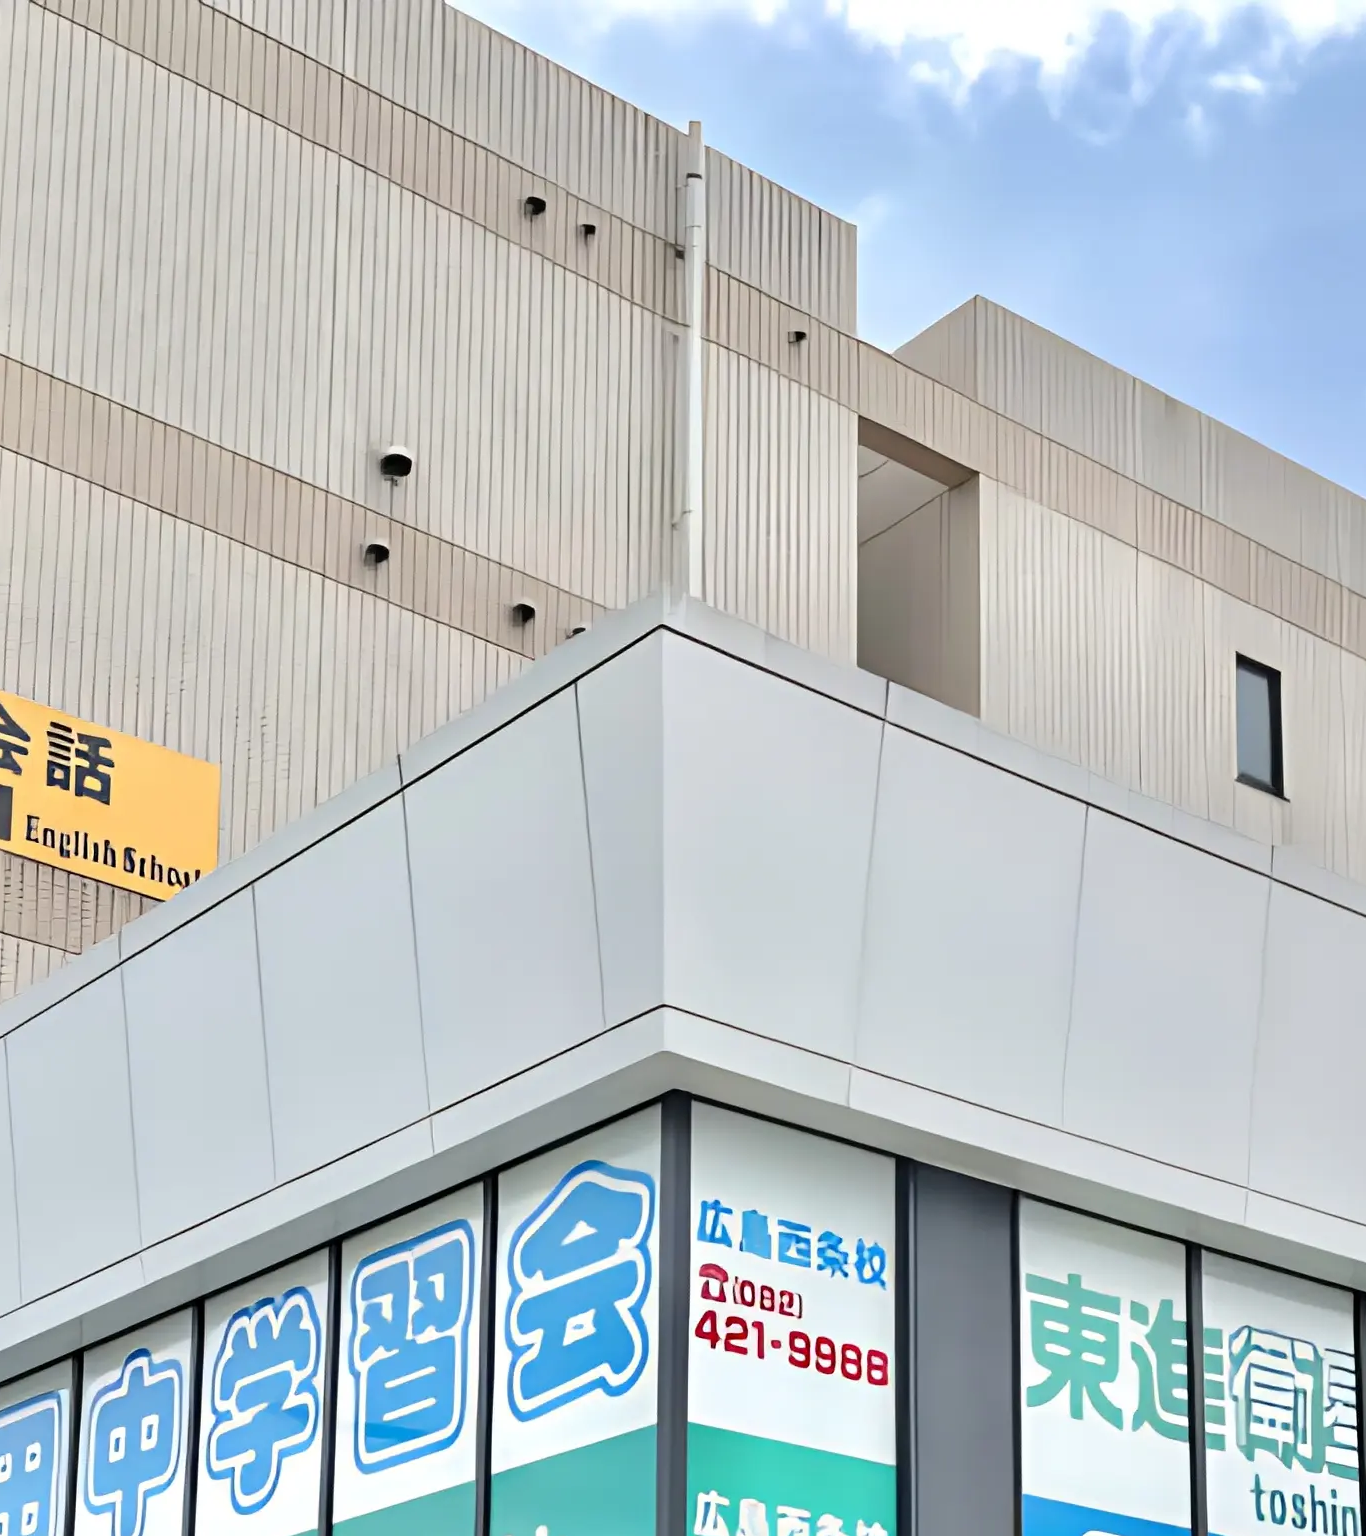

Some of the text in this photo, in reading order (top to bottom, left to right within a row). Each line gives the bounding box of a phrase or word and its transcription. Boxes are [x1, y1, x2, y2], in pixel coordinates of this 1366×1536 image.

[25, 814, 117, 870] English
[697, 1199, 887, 1291] 広島西条校
[694, 1309, 889, 1386] 421-9988
